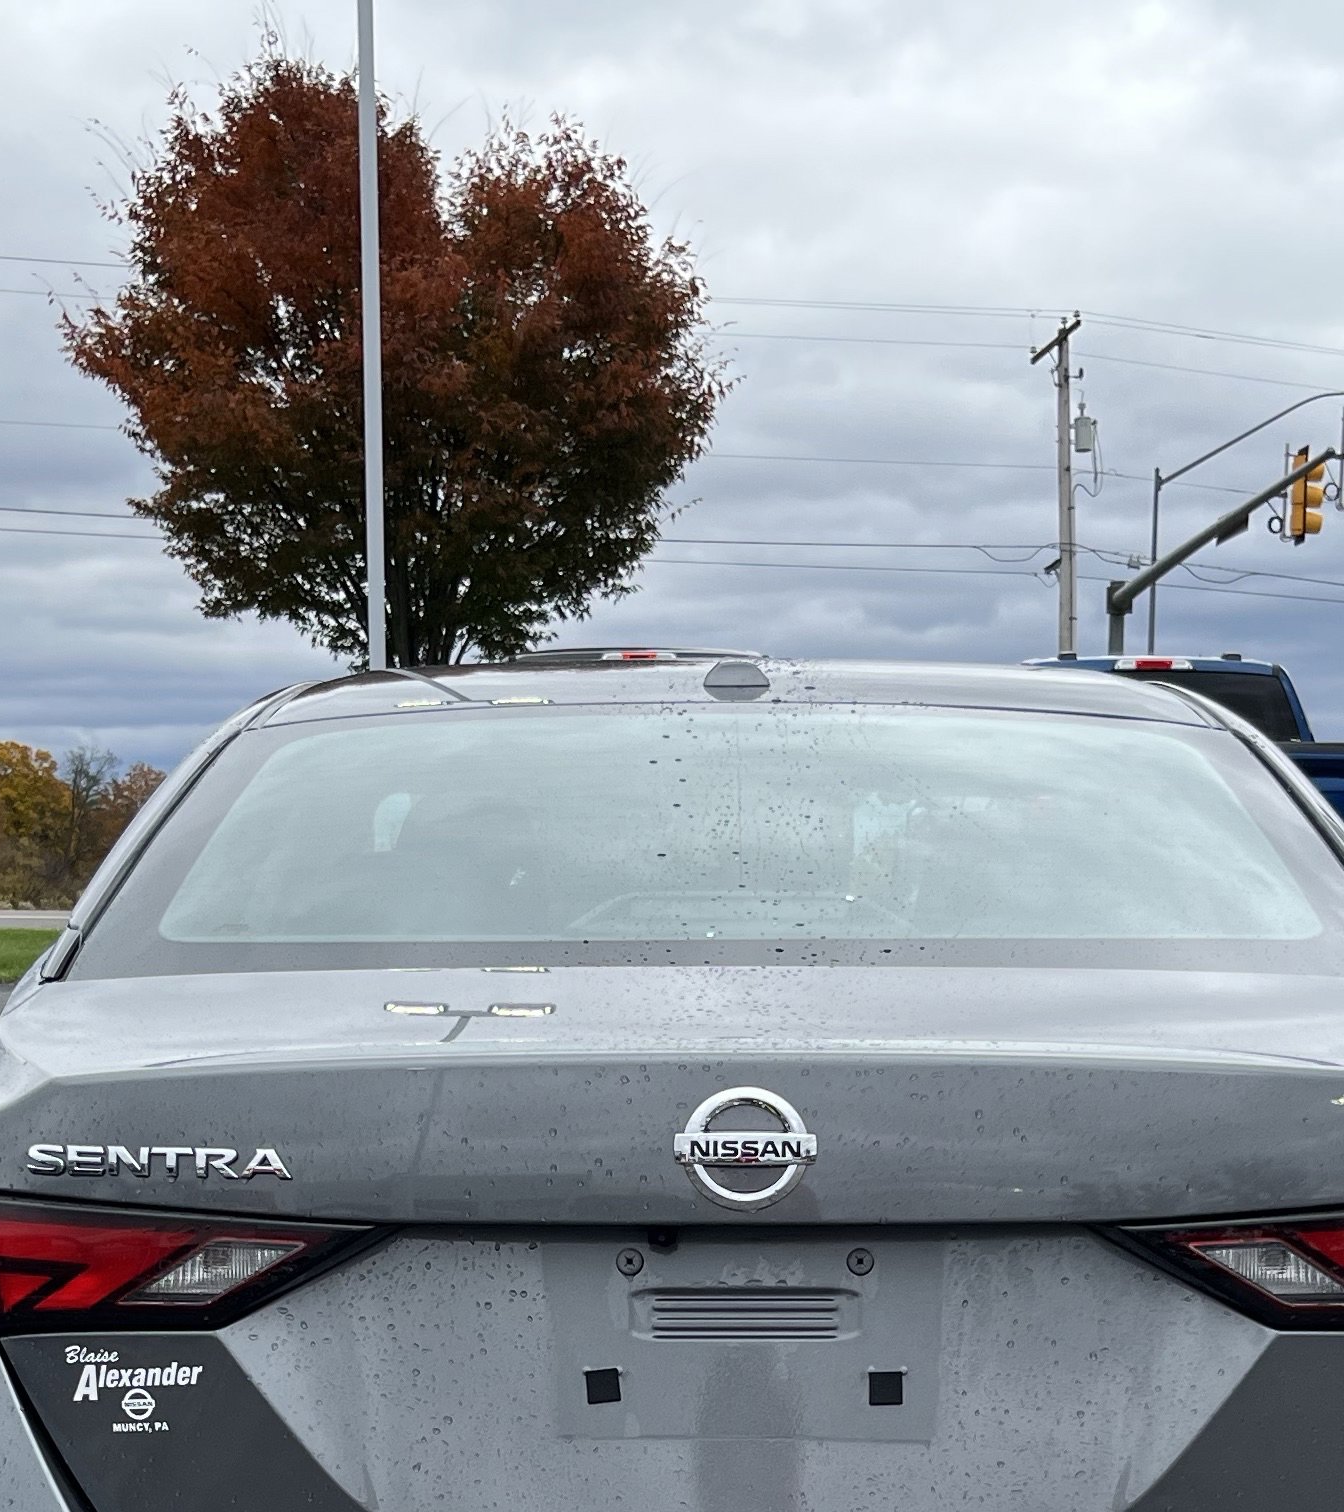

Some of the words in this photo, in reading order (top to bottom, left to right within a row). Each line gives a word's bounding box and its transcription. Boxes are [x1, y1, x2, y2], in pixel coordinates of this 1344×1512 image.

[689, 1140, 802, 1158] NISSAN
[26, 1144, 294, 1181] SENTRA
[64, 1345, 120, 1364] Blaise
[72, 1361, 204, 1402] Alexander
[112, 1423, 153, 1433] MUNCY,
[154, 1421, 170, 1431] PA
